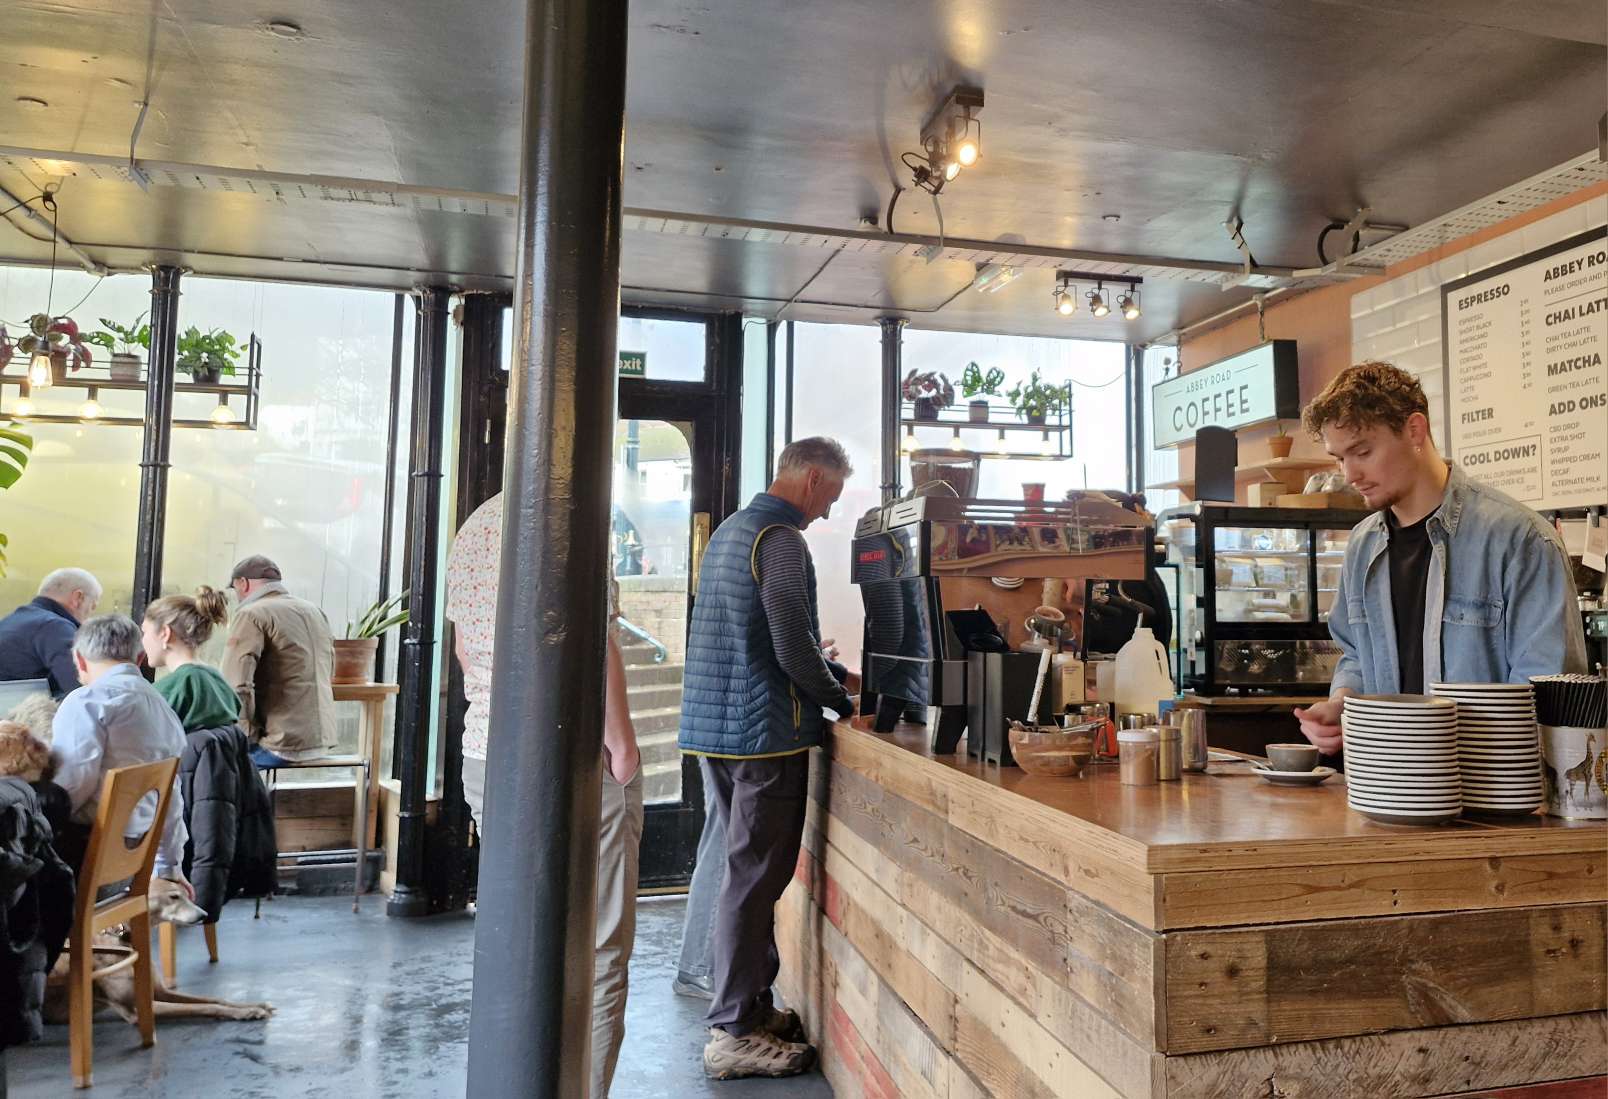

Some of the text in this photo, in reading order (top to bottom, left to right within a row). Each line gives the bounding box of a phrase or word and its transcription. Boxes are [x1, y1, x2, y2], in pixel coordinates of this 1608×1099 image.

[1544, 251, 1608, 282] ABBEY RO
[1567, 276, 1587, 289] ORDER
[1589, 271, 1603, 282] AND
[1459, 284, 1510, 310] ESPRESSO
[1545, 307, 1575, 326] CHAI
[1546, 326, 1591, 344] CHAI TEA LATTE
[1547, 335, 1598, 354] DIRTY CHAI LATTE
[1547, 352, 1602, 377] MATCHA
[1186, 370, 1231, 393] ABBEY ROAD
[1548, 375, 1600, 394] GREEN TEA LATTE
[1173, 384, 1250, 432] COFFEE
[1549, 393, 1606, 416] ADD ONS
[1461, 407, 1494, 424] FILTER
[1563, 421, 1580, 431] DROP
[1550, 431, 1586, 444] EXTRA SHOT
[1463, 444, 1537, 466] COOL DOWN?
[1550, 445, 1570, 455] SYRUP
[1551, 452, 1601, 466] WHIPPED CREAM
[1551, 467, 1570, 477] DECAF
[1552, 473, 1601, 488] ALTERNATE MILK
